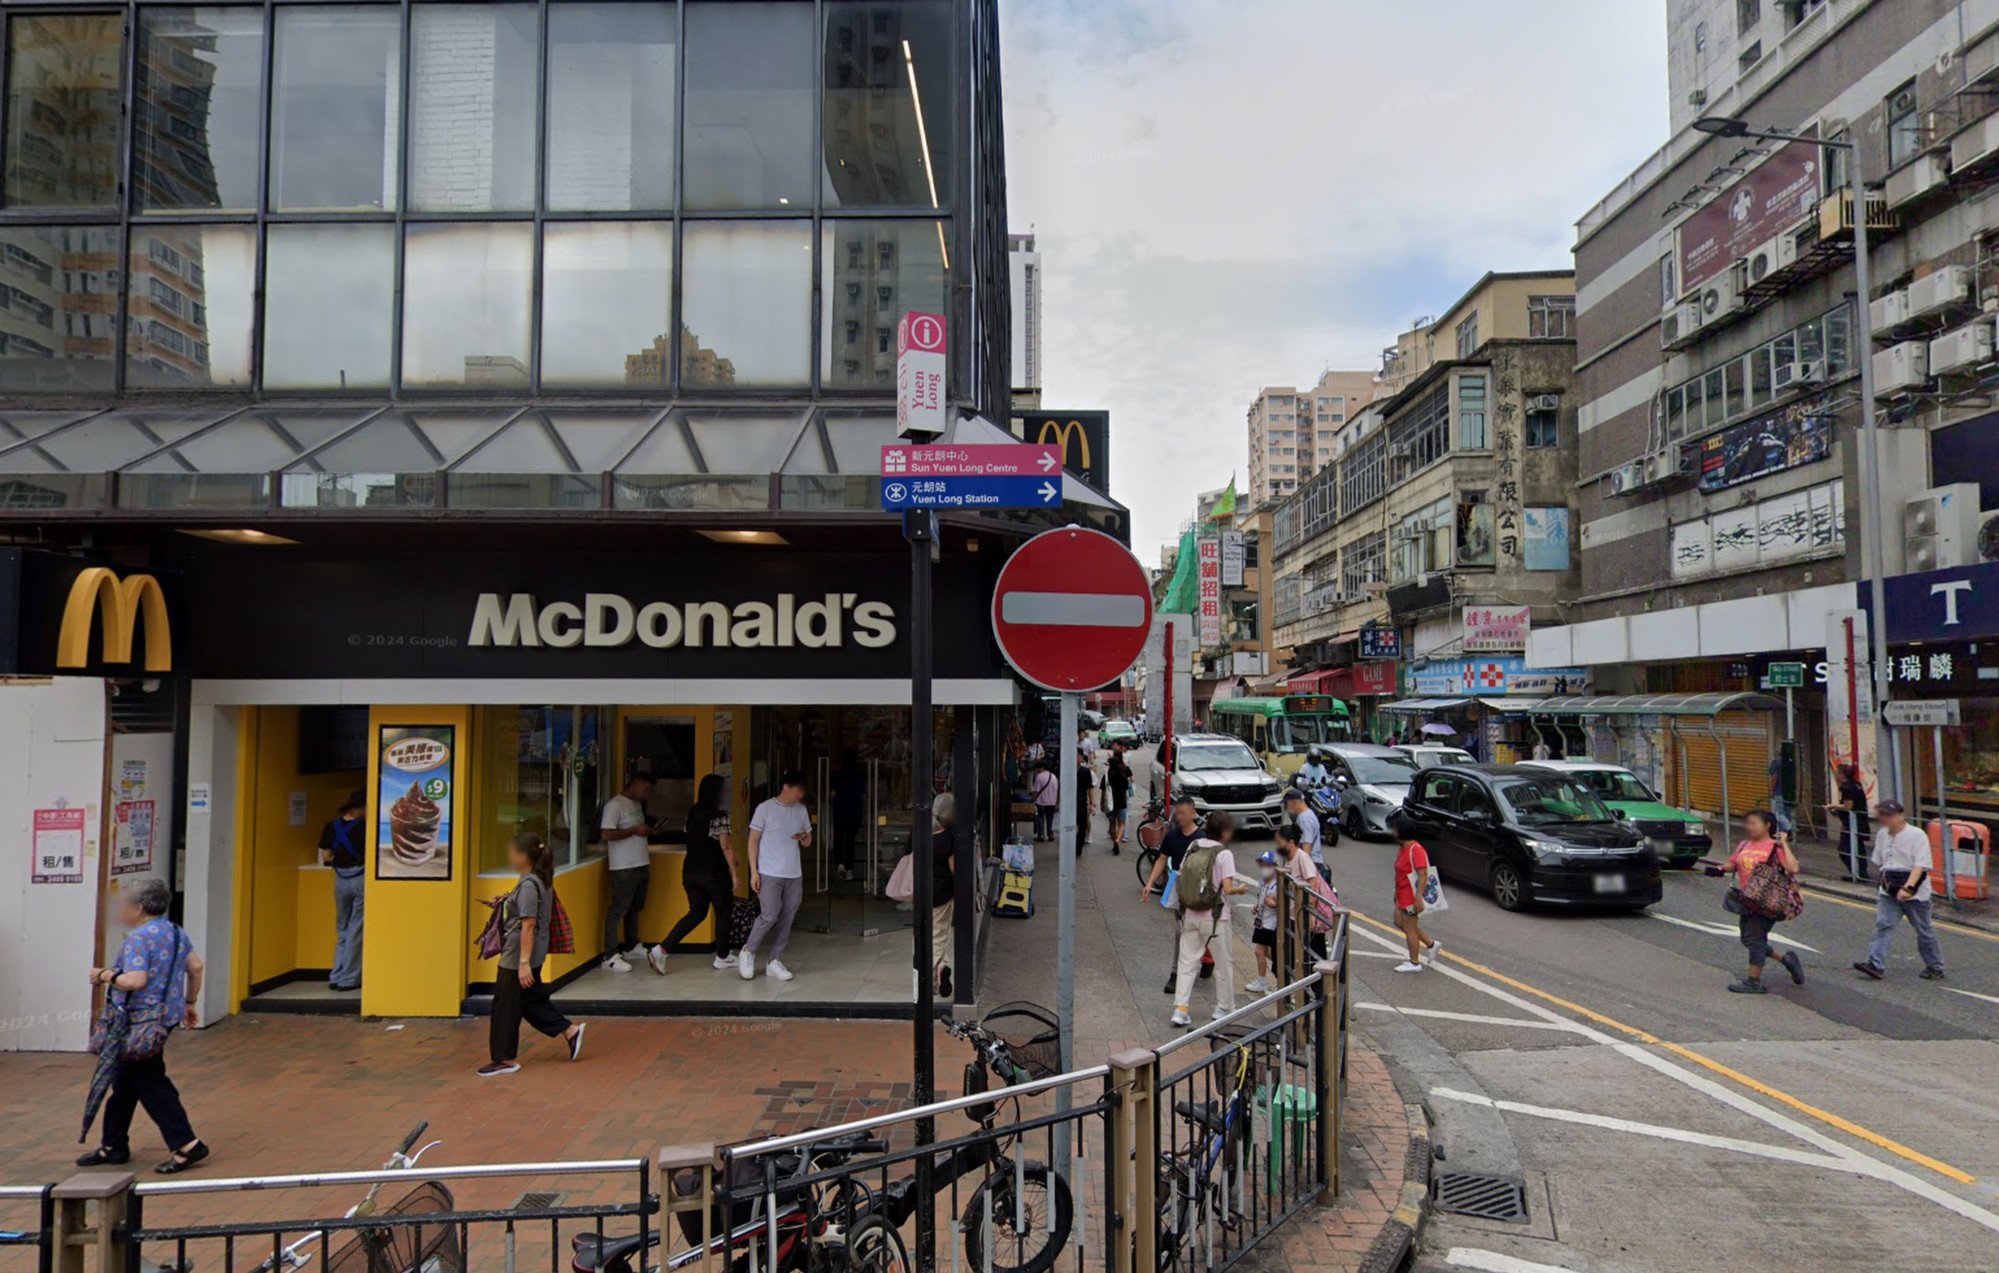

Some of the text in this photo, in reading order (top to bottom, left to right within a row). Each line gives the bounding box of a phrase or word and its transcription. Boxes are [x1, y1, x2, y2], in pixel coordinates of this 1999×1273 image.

[912, 371, 925, 409] Yuen
[925, 374, 941, 411] Long
[911, 450, 969, 462] 新元朗中心
[911, 463, 1018, 474] Sun Yuen Long Centre
[912, 481, 947, 493] 元朗站
[911, 494, 999, 505] Yuen Long Station
[1930, 579, 1973, 626] T
[467, 592, 897, 648] McDonald's
[427, 779, 444, 794] $9
